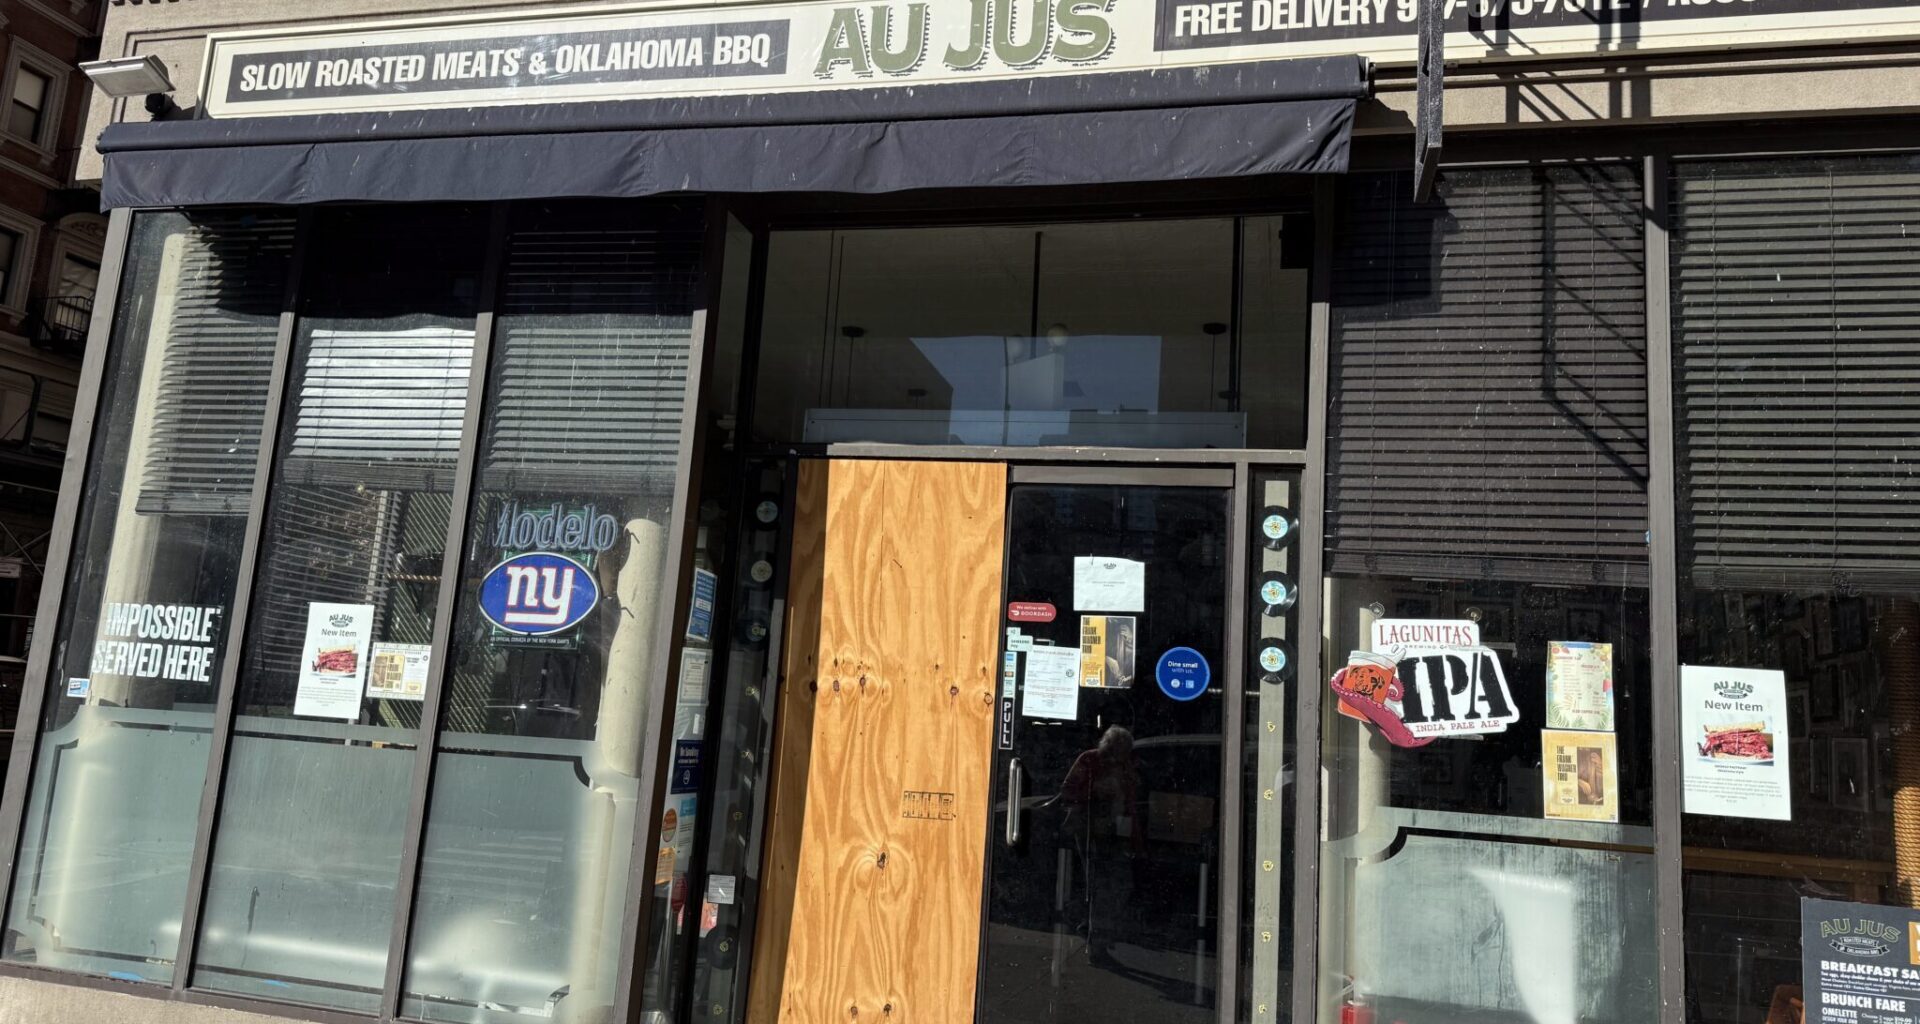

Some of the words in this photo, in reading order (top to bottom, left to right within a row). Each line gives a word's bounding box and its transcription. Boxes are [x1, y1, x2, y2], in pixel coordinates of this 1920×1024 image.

[1174, 2, 1242, 37] FREE
[1251, 0, 1389, 31] DELIVERY
[813, 4, 930, 79] AU
[942, 0, 1116, 70] JUS
[240, 61, 311, 92] SLOW
[315, 54, 426, 88] ROASTED
[431, 49, 521, 80] MEATS
[528, 52, 547, 74] &
[555, 37, 703, 73] OKLAHOMA
[712, 33, 771, 67] BBQ
[104, 602, 216, 642] IMPOSSIBLE
[321, 628, 338, 636] New
[340, 630, 357, 638] Item
[1379, 624, 1473, 647] LAGUNITAS
[92, 640, 163, 678] SERVED
[162, 644, 214, 682] HERE
[1396, 651, 1513, 724] IPA
[1714, 680, 1729, 691] AU
[1730, 681, 1754, 694] JUS
[1704, 700, 1732, 710] New
[1736, 702, 1764, 712] Item
[1003, 702, 1012, 744] PULL
[1416, 724, 1445, 732] INDIA
[1451, 722, 1475, 730] PALE
[1480, 720, 1500, 728] ALE
[1820, 918, 1851, 938] AU
[1854, 919, 1901, 943] JUS
[1820, 960, 1899, 978] BREAKFAST
[1901, 968, 1920, 980] SA
[1822, 992, 1872, 1009] BRUNCH
[1876, 998, 1906, 1012] FARE
[1822, 1007, 1857, 1018] OMELETTE
